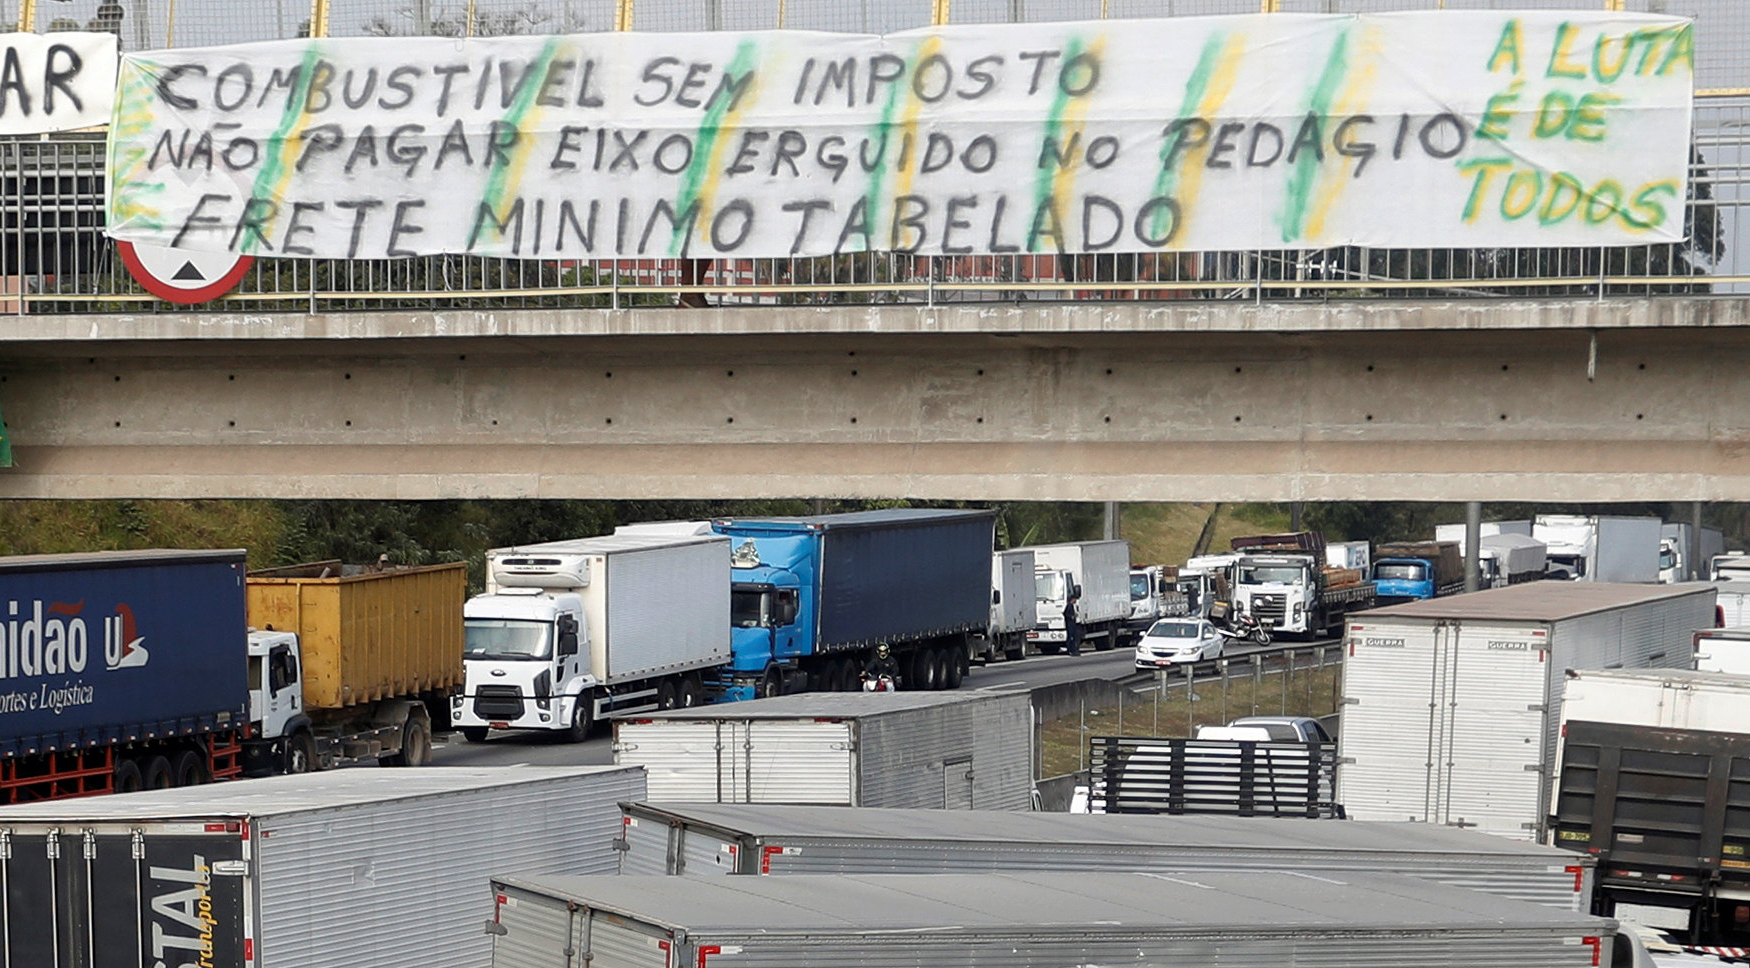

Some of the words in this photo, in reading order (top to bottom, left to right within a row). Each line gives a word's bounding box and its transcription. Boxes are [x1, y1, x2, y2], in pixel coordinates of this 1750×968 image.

[156, 58, 604, 116] COMBUSTIVEL
[635, 56, 755, 111] SEM
[794, 50, 1100, 108] IMPOSTO
[1487, 19, 1524, 74] A
[1545, 21, 1694, 84] LUTA
[1474, 81, 1528, 140] É
[1533, 92, 1624, 142] DE
[148, 122, 259, 172] NÃO
[295, 119, 521, 176] PAGAR
[550, 125, 693, 174] EIXO
[726, 130, 998, 184] ERGUIDO
[1038, 132, 1120, 171] NO
[1162, 111, 1469, 177] PEDAGIO
[171, 194, 426, 258] FRETE
[467, 196, 755, 257] MINIMO
[782, 193, 1185, 255] TABELADO
[1455, 158, 1682, 235] TODOS
[29, 692, 38, 711] e
[39, 679, 94, 717] Logística
